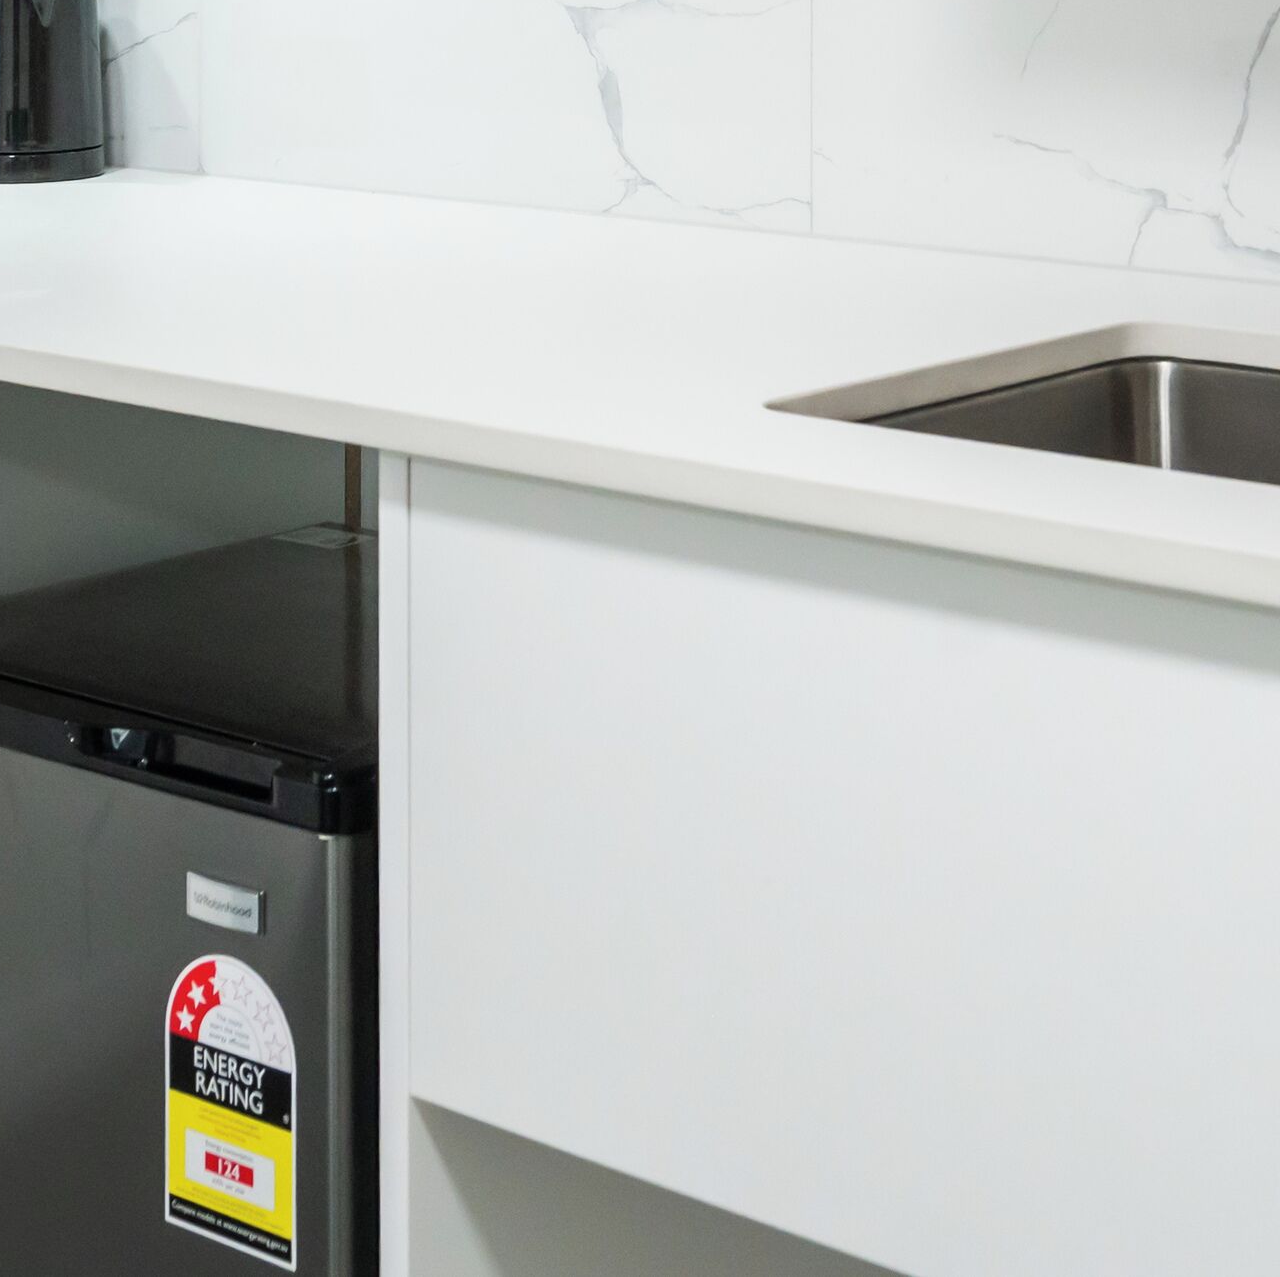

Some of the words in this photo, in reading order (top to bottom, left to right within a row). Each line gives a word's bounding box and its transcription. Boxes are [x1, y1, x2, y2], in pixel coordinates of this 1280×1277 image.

[193, 1045, 266, 1090] ENERGY
[195, 1070, 263, 1115] RATING
[218, 1158, 240, 1181] 124
